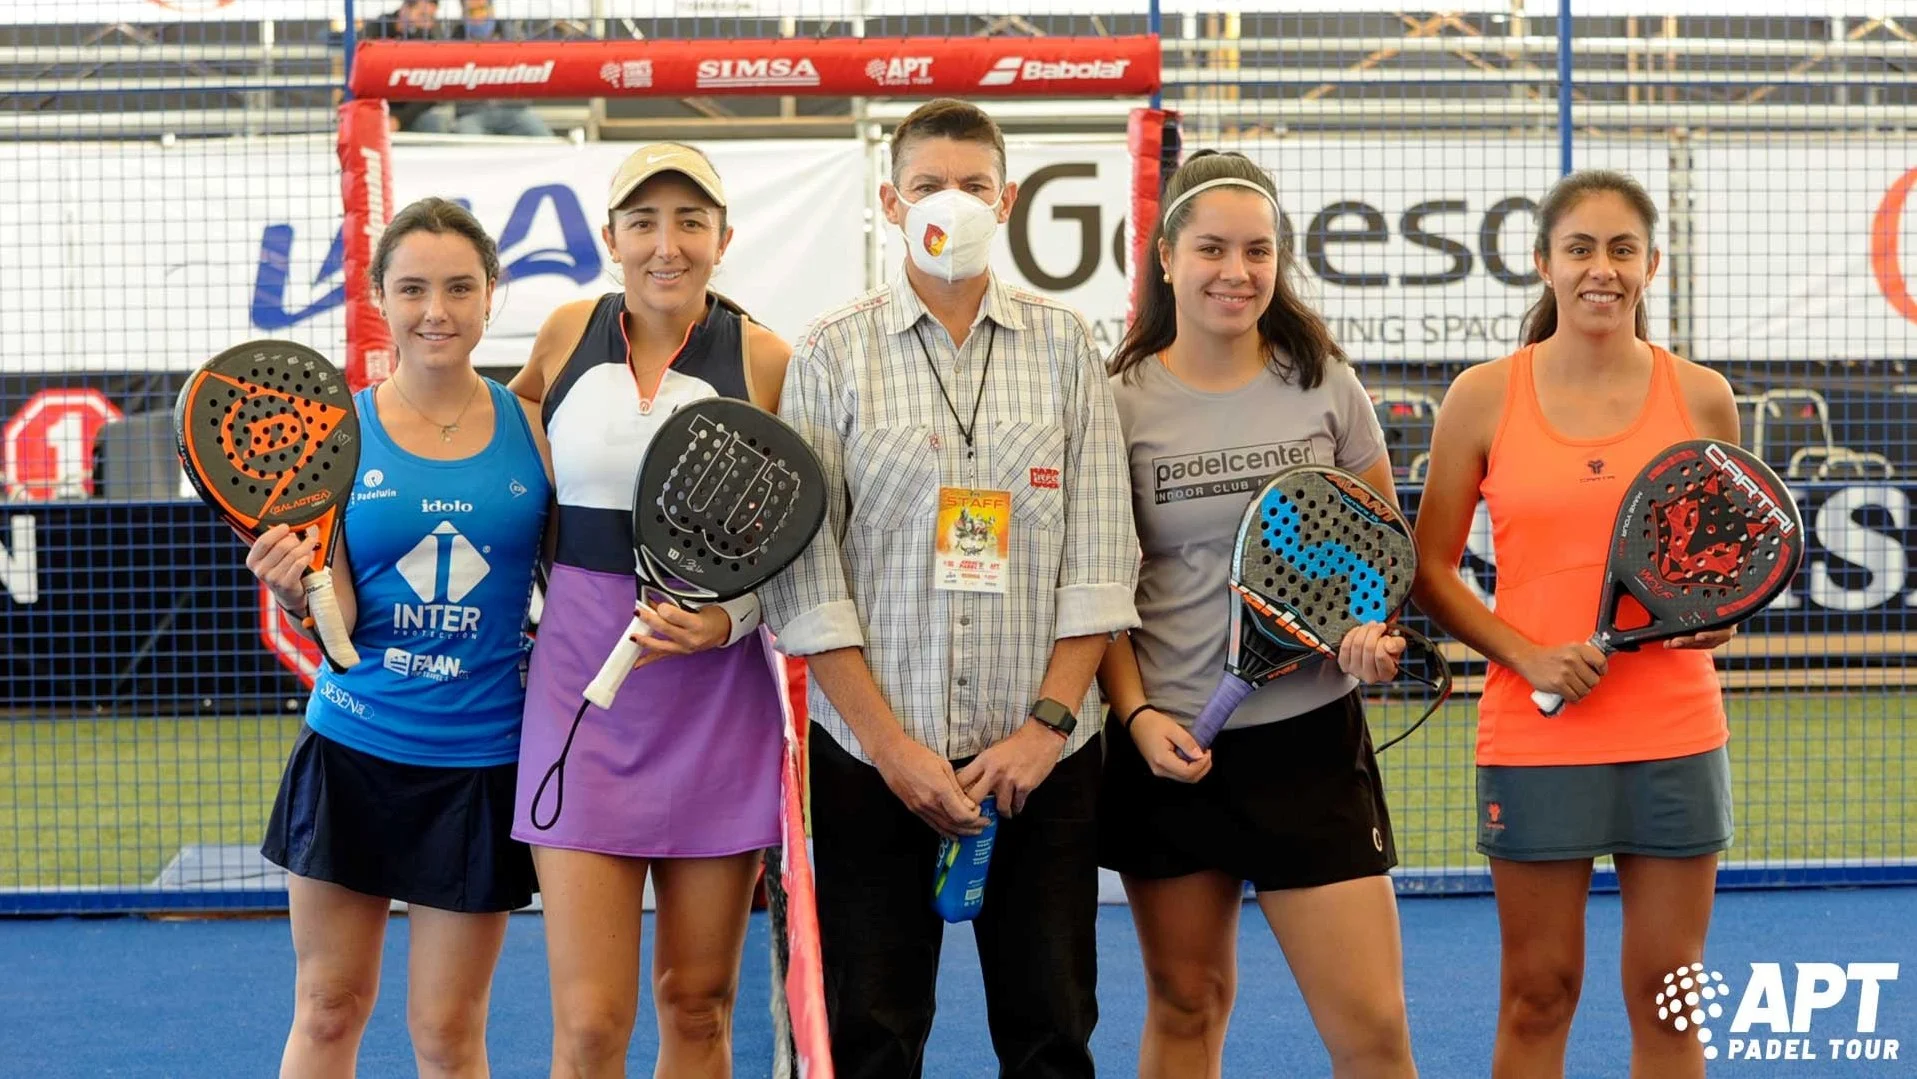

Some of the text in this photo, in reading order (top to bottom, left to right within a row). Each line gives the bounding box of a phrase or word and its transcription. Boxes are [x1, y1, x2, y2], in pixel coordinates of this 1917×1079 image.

[388, 61, 556, 91] royalpadel
[696, 58, 820, 79] SIMSA
[886, 57, 934, 79] APT
[1156, 443, 1312, 489] padelcenter
[357, 488, 397, 501] PadelWin
[1155, 484, 1205, 502] INDOOR
[1213, 480, 1250, 495] CLUB
[1703, 442, 1796, 536] CARTRI
[273, 489, 330, 514] GALACTICA
[421, 499, 474, 513] idolo
[946, 495, 1006, 509] STAFF
[394, 602, 481, 633] INTER
[394, 629, 478, 641] PROTECTION
[411, 654, 461, 678] FAAN
